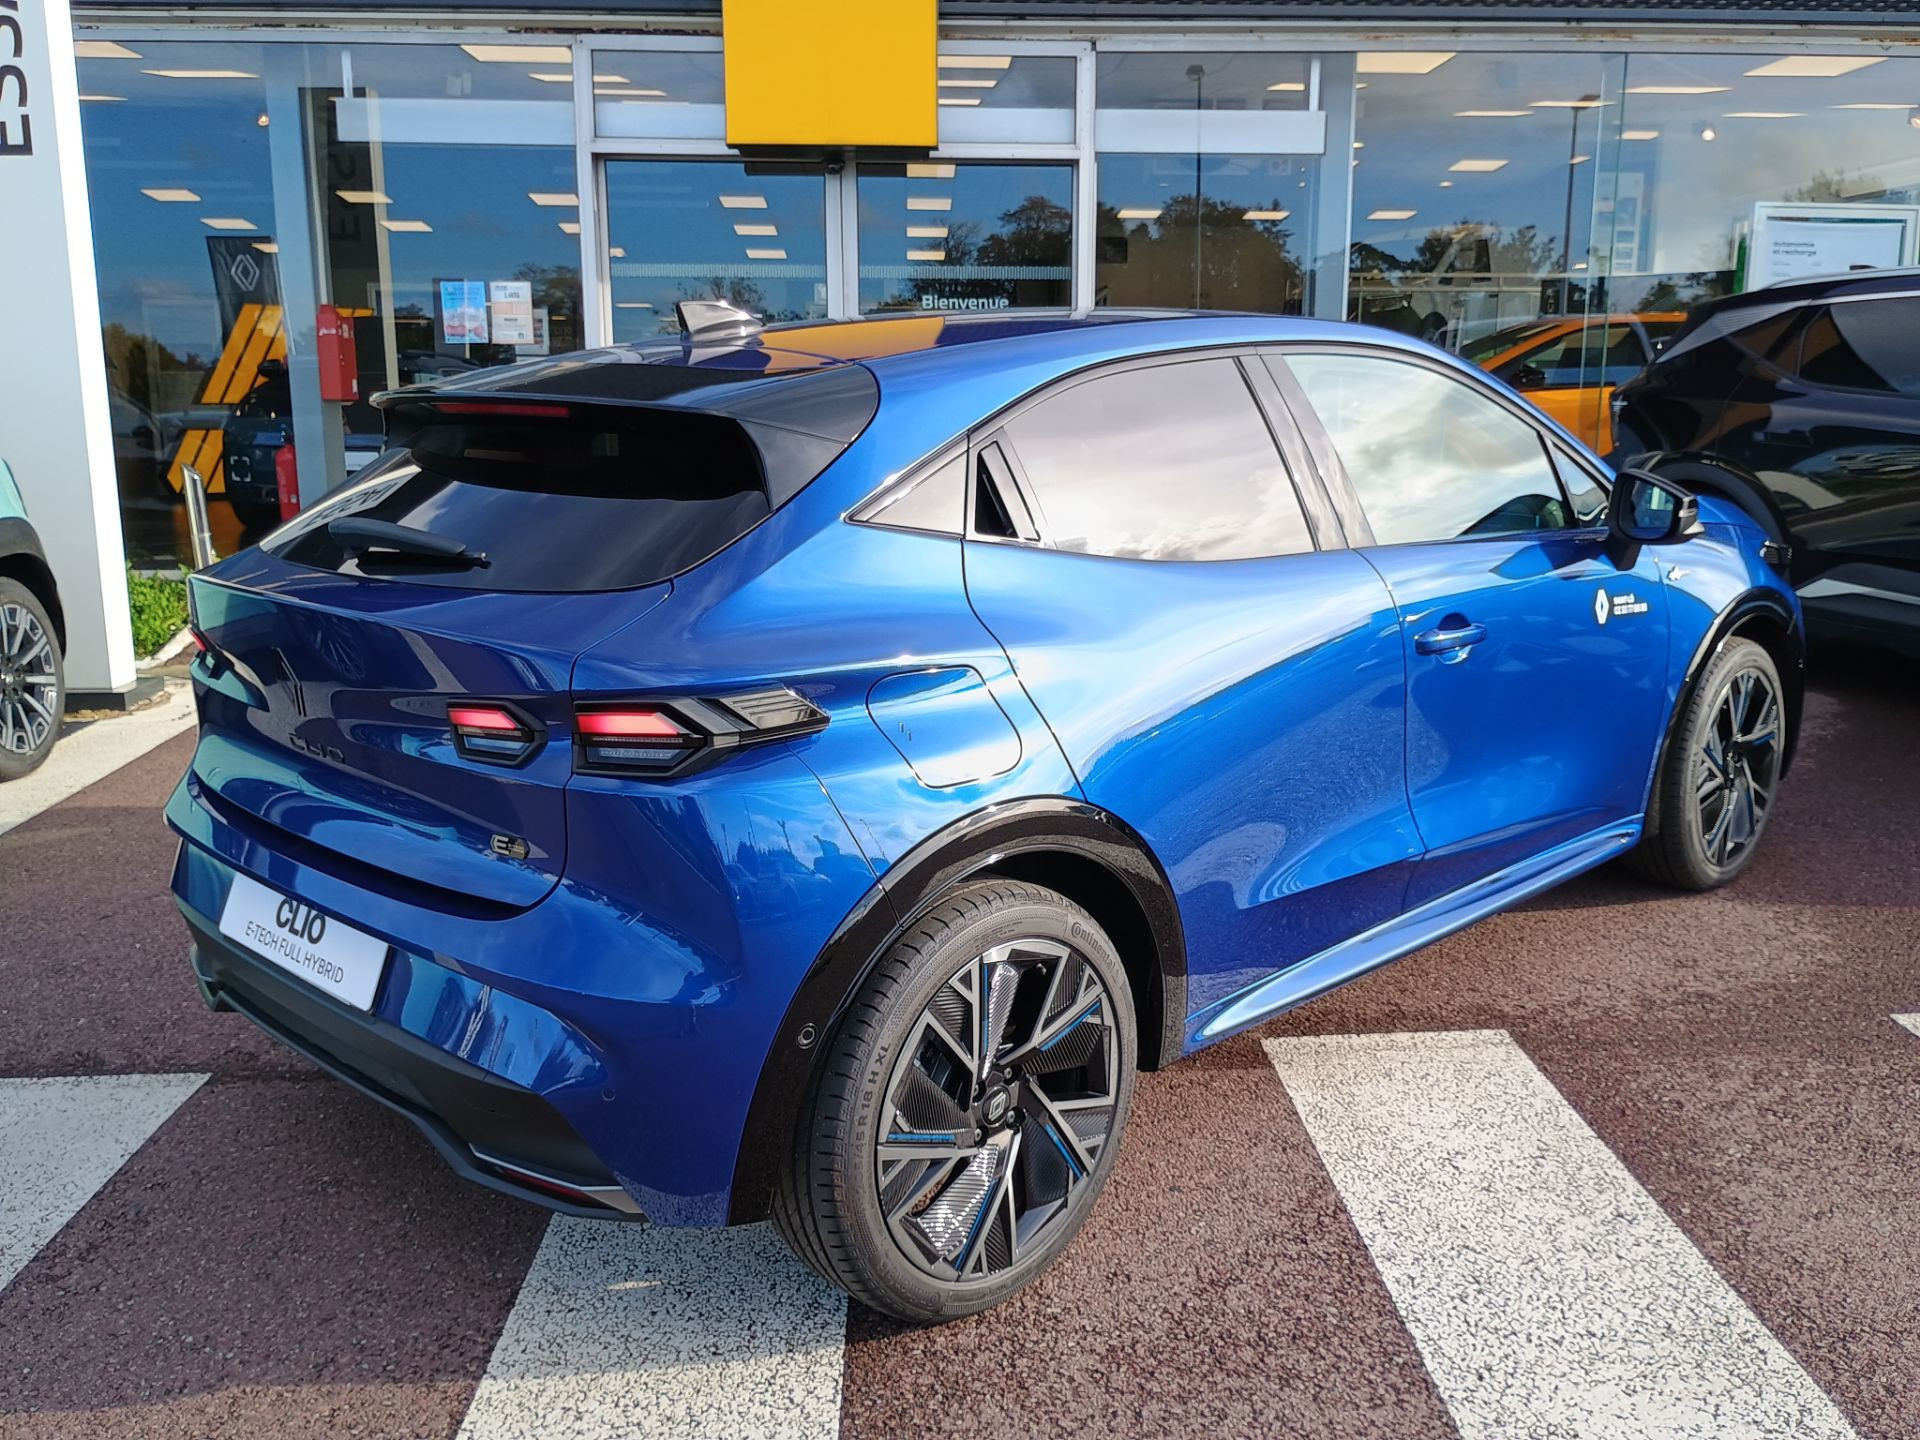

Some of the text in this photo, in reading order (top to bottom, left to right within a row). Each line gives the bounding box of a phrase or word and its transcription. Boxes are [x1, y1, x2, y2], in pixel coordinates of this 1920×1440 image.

[922, 294, 1009, 310] Bienvenue
[276, 897, 327, 945] CLIO
[245, 920, 345, 984] E-TECH FULL HYBRID
[868, 1070, 880, 1085] H
[874, 1042, 891, 1066] XL
